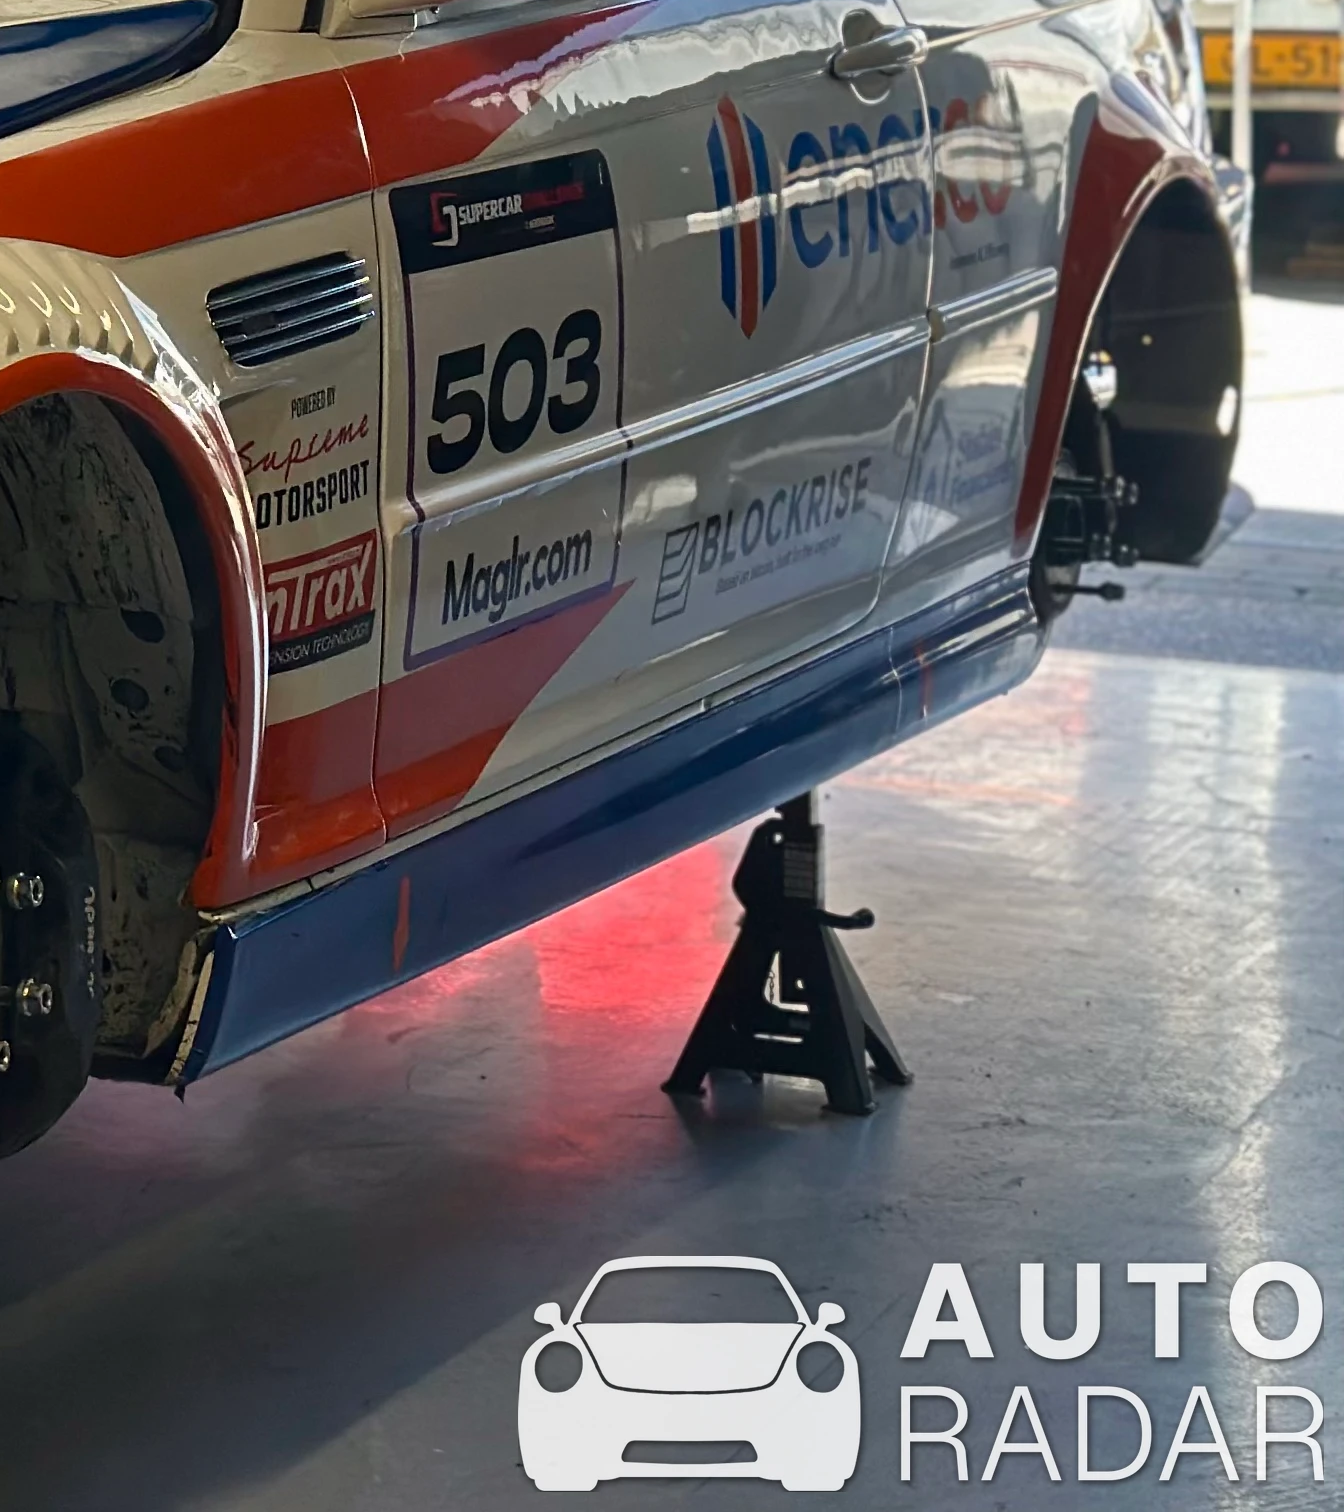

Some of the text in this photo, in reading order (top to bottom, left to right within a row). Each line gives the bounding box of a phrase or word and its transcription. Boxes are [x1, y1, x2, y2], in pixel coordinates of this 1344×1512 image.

[458, 193, 523, 226] SUPERCAR
[290, 385, 337, 419] POWERED BY
[426, 309, 603, 475] 503
[251, 460, 370, 530] OTORSPORT
[698, 456, 872, 575] BLOCKRISE
[266, 539, 374, 636] nTrax
